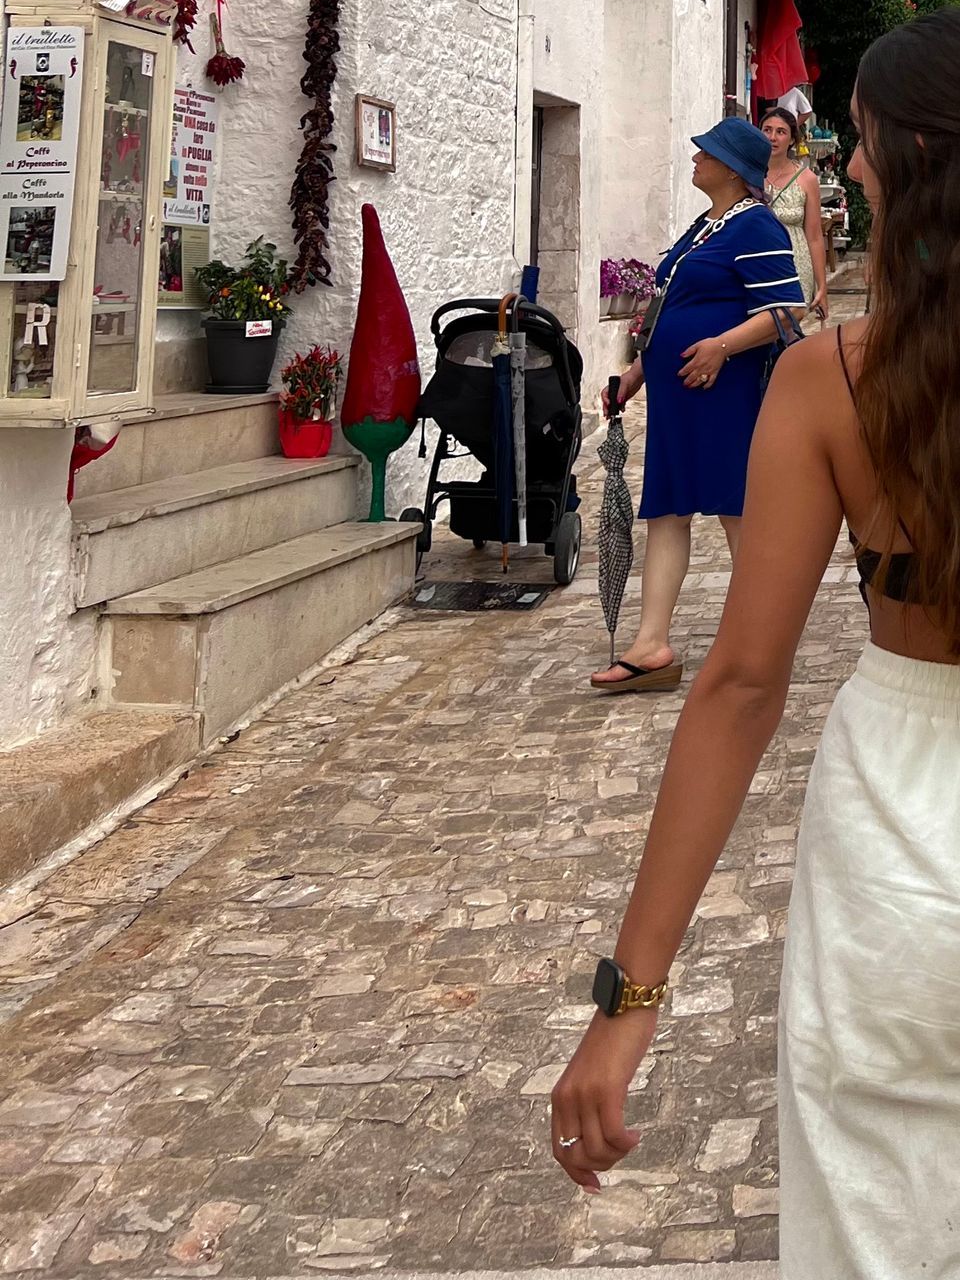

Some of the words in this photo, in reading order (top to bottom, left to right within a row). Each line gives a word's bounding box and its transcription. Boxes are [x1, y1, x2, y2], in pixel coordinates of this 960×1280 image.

[12, 32, 25, 45] il
[25, 32, 75, 45] trulletto
[184, 115, 196, 129] UNA
[197, 120, 208, 131] cosa
[209, 121, 215, 133] da
[187, 146, 213, 161] PUGLIA
[16, 159, 68, 170] Peperoncino
[2, 191, 18, 199] alla
[20, 191, 65, 201] Mandorla
[186, 188, 203, 202] VITA
